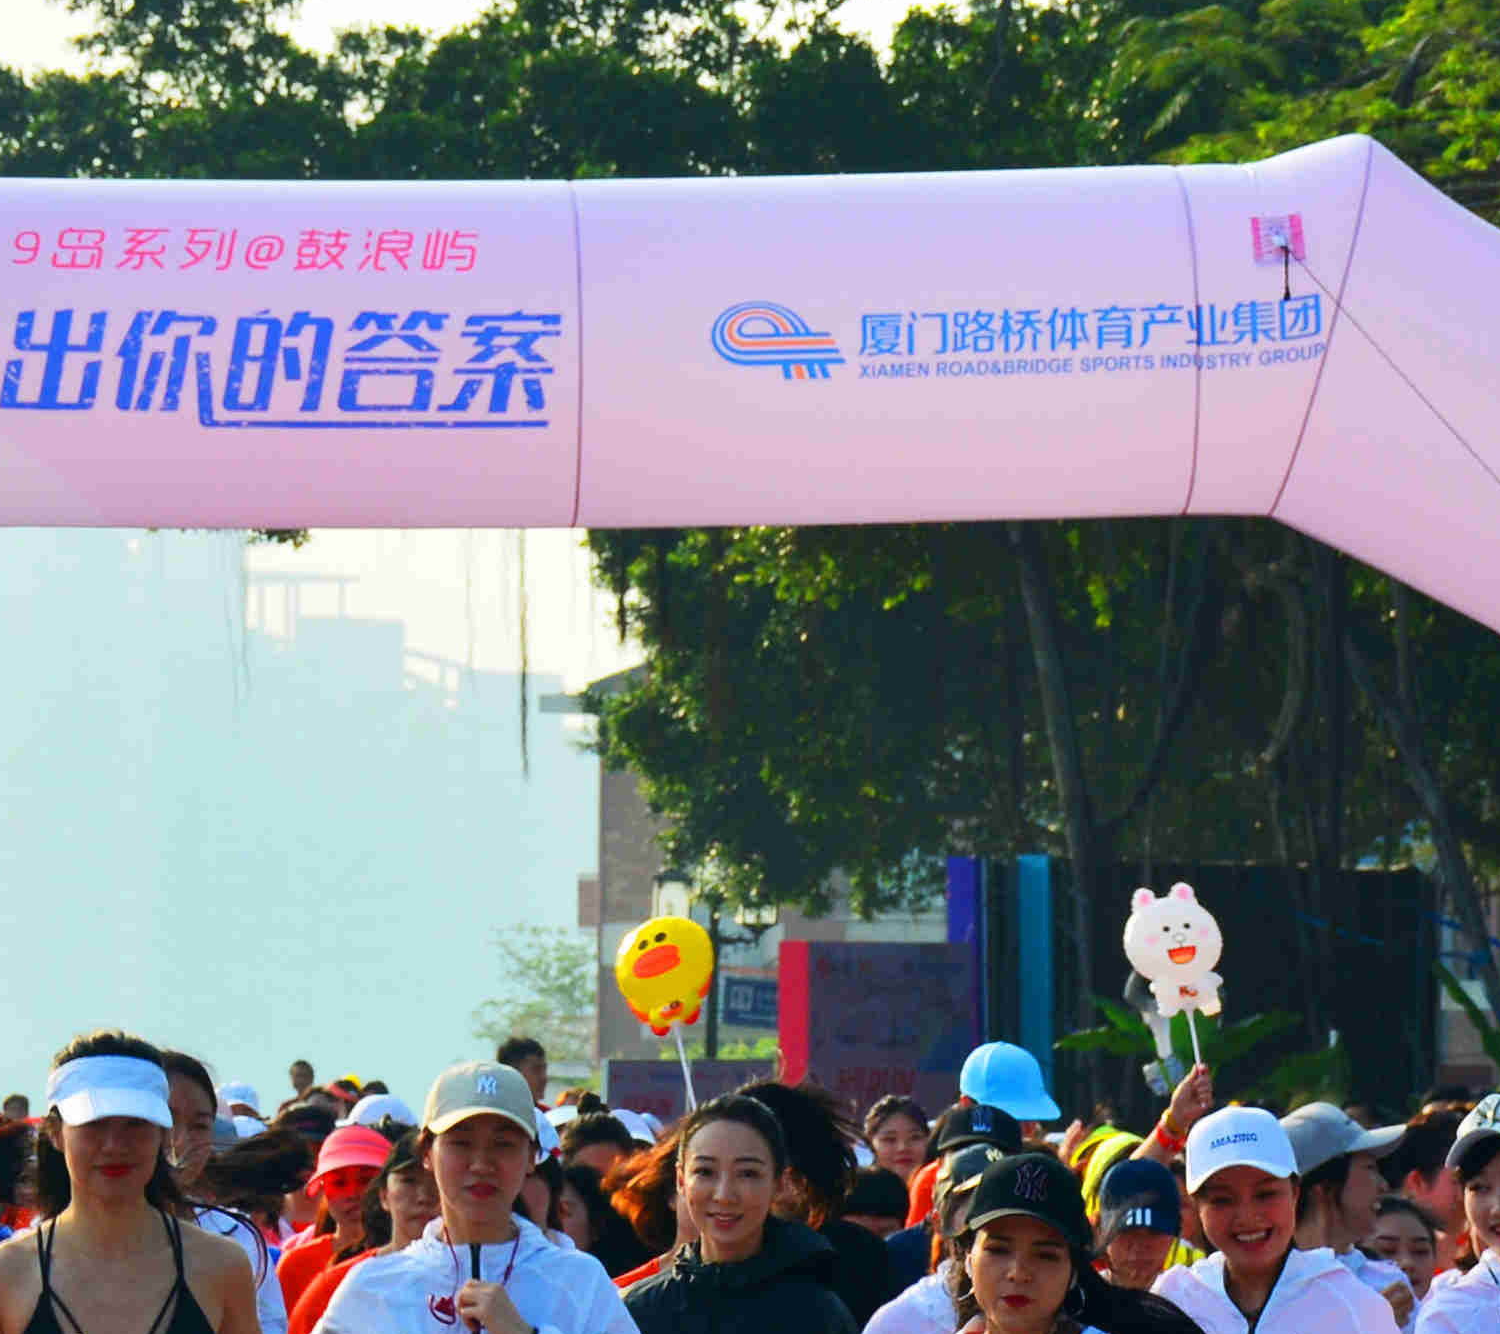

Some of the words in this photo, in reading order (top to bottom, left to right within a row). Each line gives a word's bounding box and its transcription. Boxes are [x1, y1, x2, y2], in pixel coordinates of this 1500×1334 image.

[857, 292, 1322, 357] 厦门路桥体育产业集团
[857, 361, 930, 381] XIAMEN
[935, 355, 1073, 378] ROAD&BRIDGE
[1080, 352, 1155, 373] SPORTS
[1160, 348, 1253, 371] INDUSTRY
[1258, 342, 1327, 365] GROUP
[1210, 1132, 1259, 1151] AMAZING
